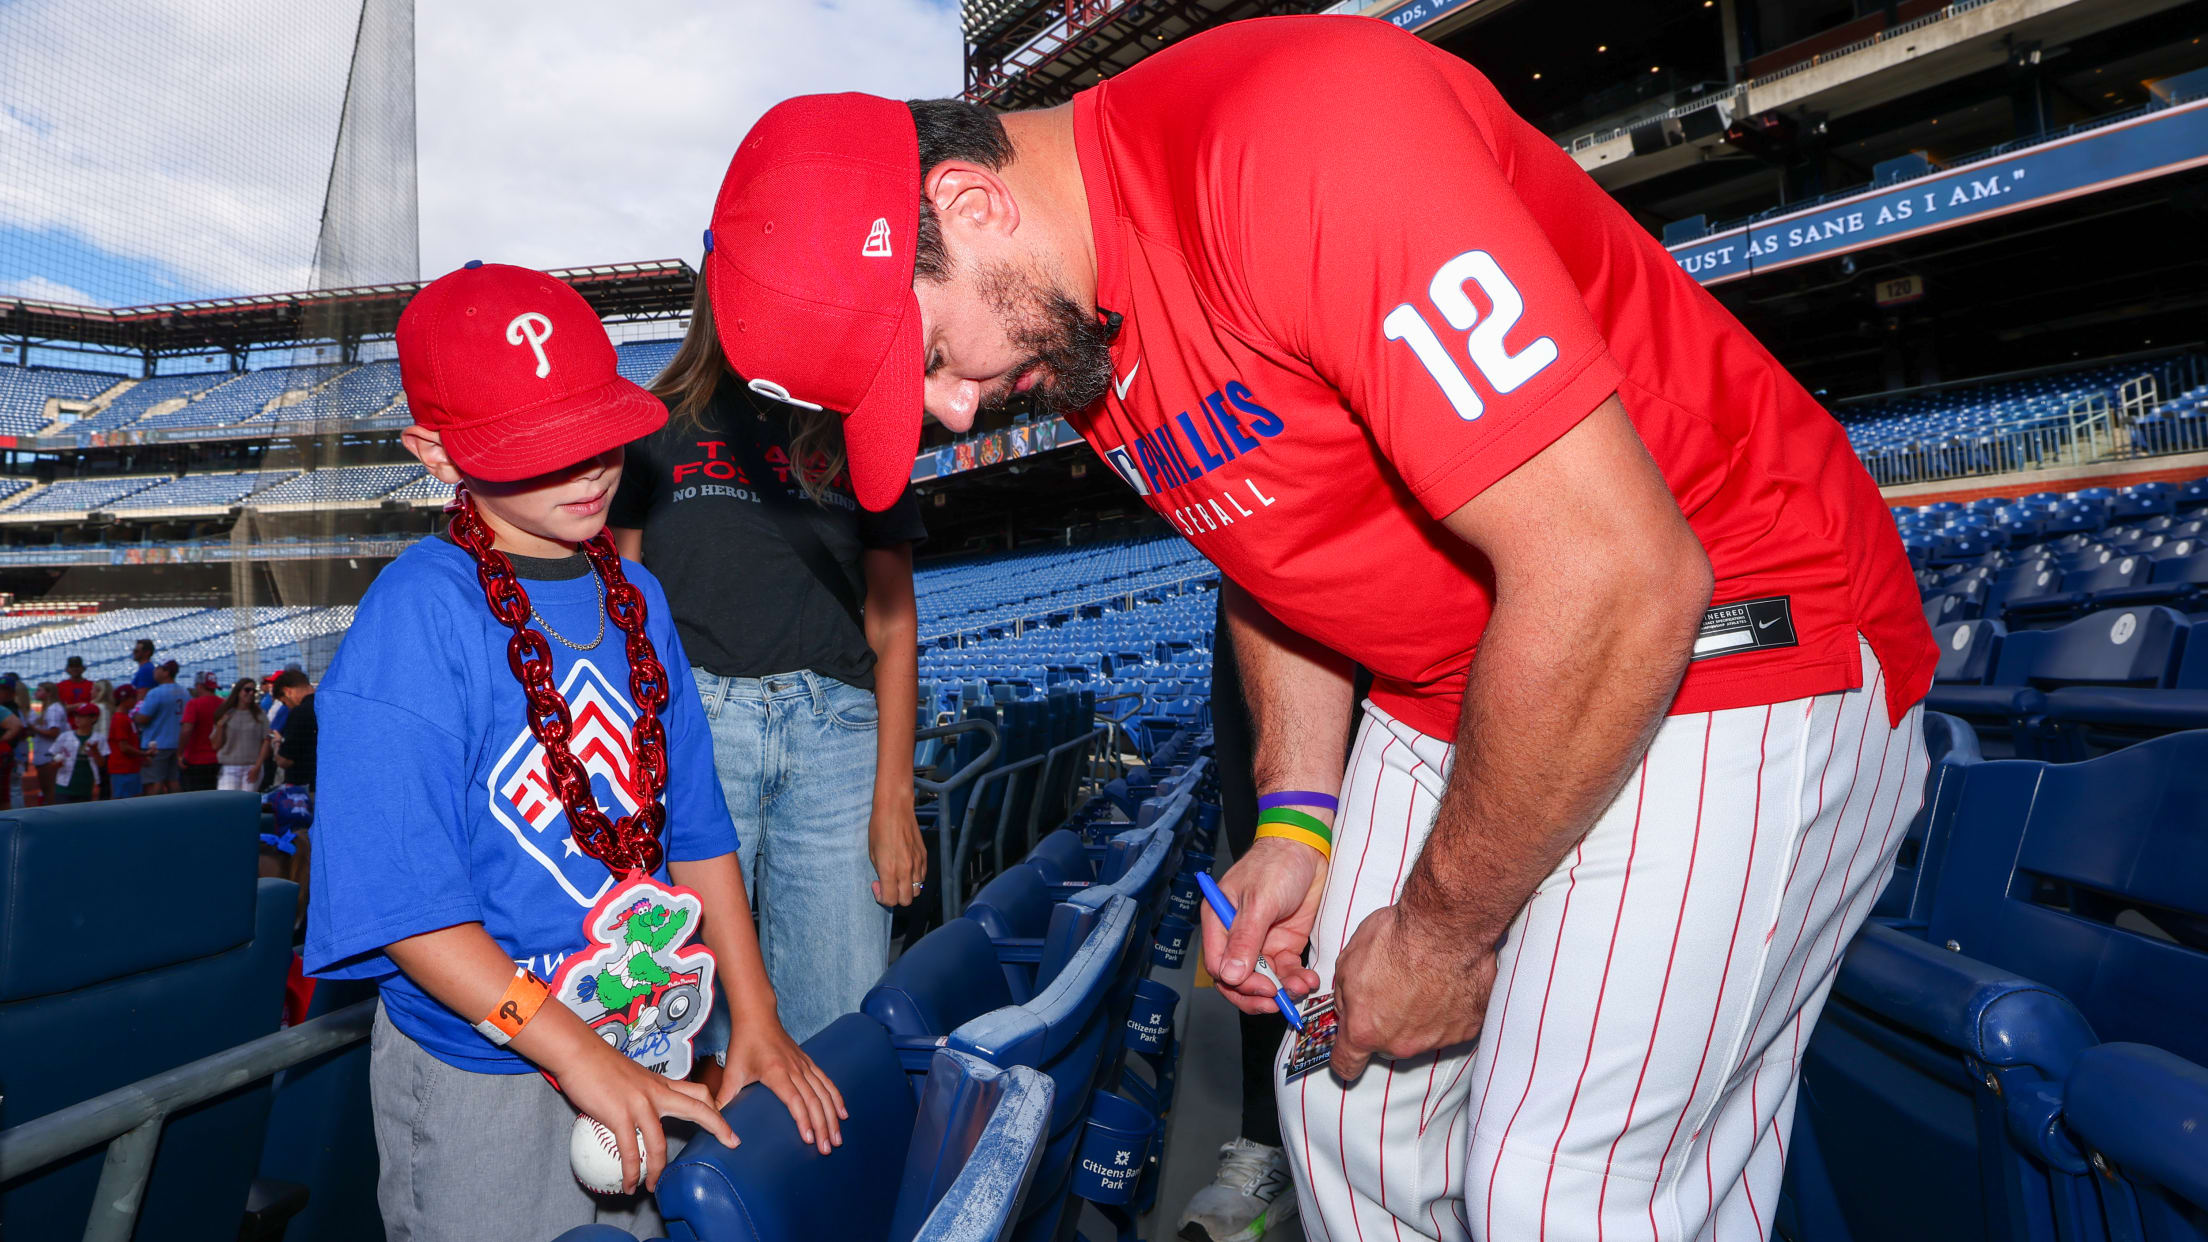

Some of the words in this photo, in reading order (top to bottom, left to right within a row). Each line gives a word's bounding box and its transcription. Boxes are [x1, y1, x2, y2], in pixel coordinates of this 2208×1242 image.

[1744, 235, 1780, 258] AS
[1788, 212, 1866, 248] SANE
[1876, 200, 1913, 226] AS
[1924, 192, 1937, 213] I
[506, 312, 554, 379] P
[1382, 248, 1558, 422] 12
[1134, 380, 1285, 494] PHILLIES
[673, 486, 698, 503] NO
[700, 484, 748, 501] HERO
[1165, 479, 1276, 535] SEBALL
[1165, 952, 1177, 961] Park
[1126, 1019, 1157, 1034] Citizens
[1140, 1032, 1157, 1044] Park
[1082, 1158, 1125, 1179] Citizens
[1125, 1168, 1141, 1178] Ban
[1101, 1177, 1124, 1190] Park
